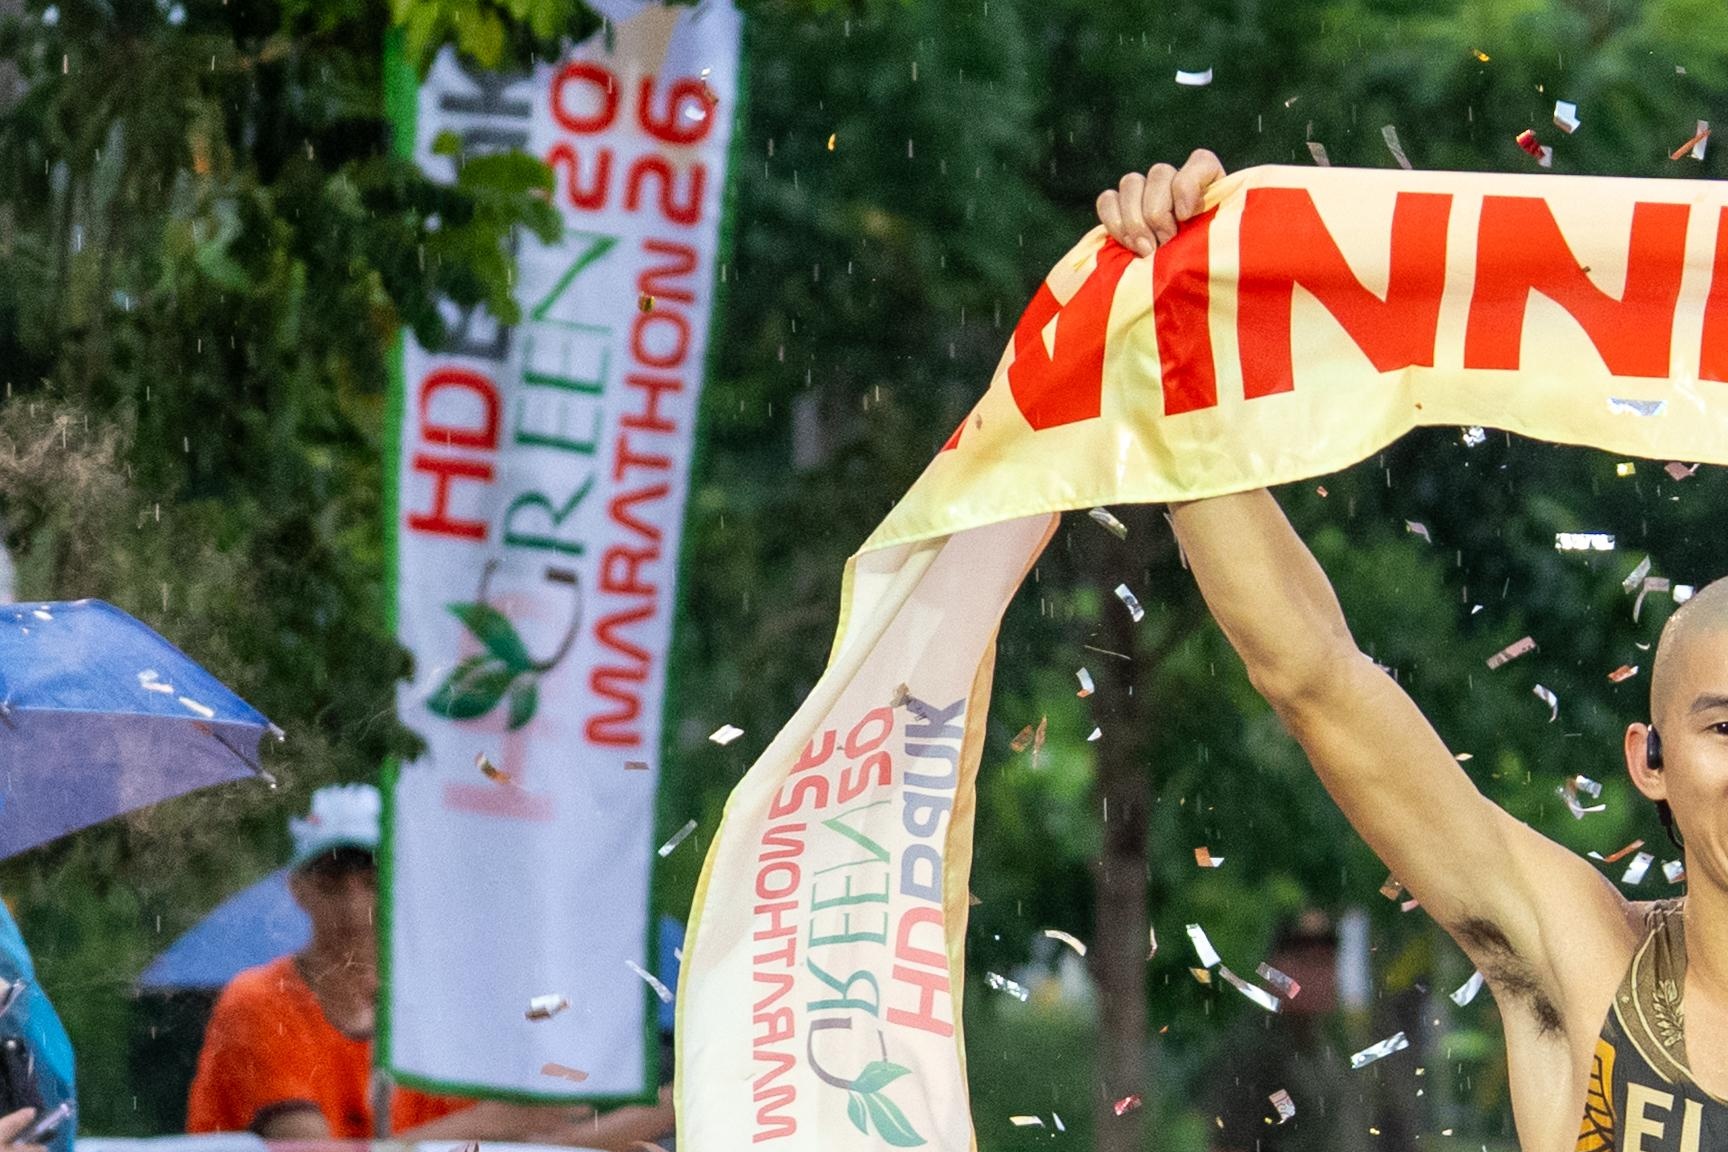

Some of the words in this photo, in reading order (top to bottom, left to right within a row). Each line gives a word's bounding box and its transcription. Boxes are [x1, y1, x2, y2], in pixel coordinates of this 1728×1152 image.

[546, 60, 619, 211] 20
[624, 78, 719, 226] 26
[477, 228, 622, 671] GREEN
[583, 238, 698, 748] MARATHON
